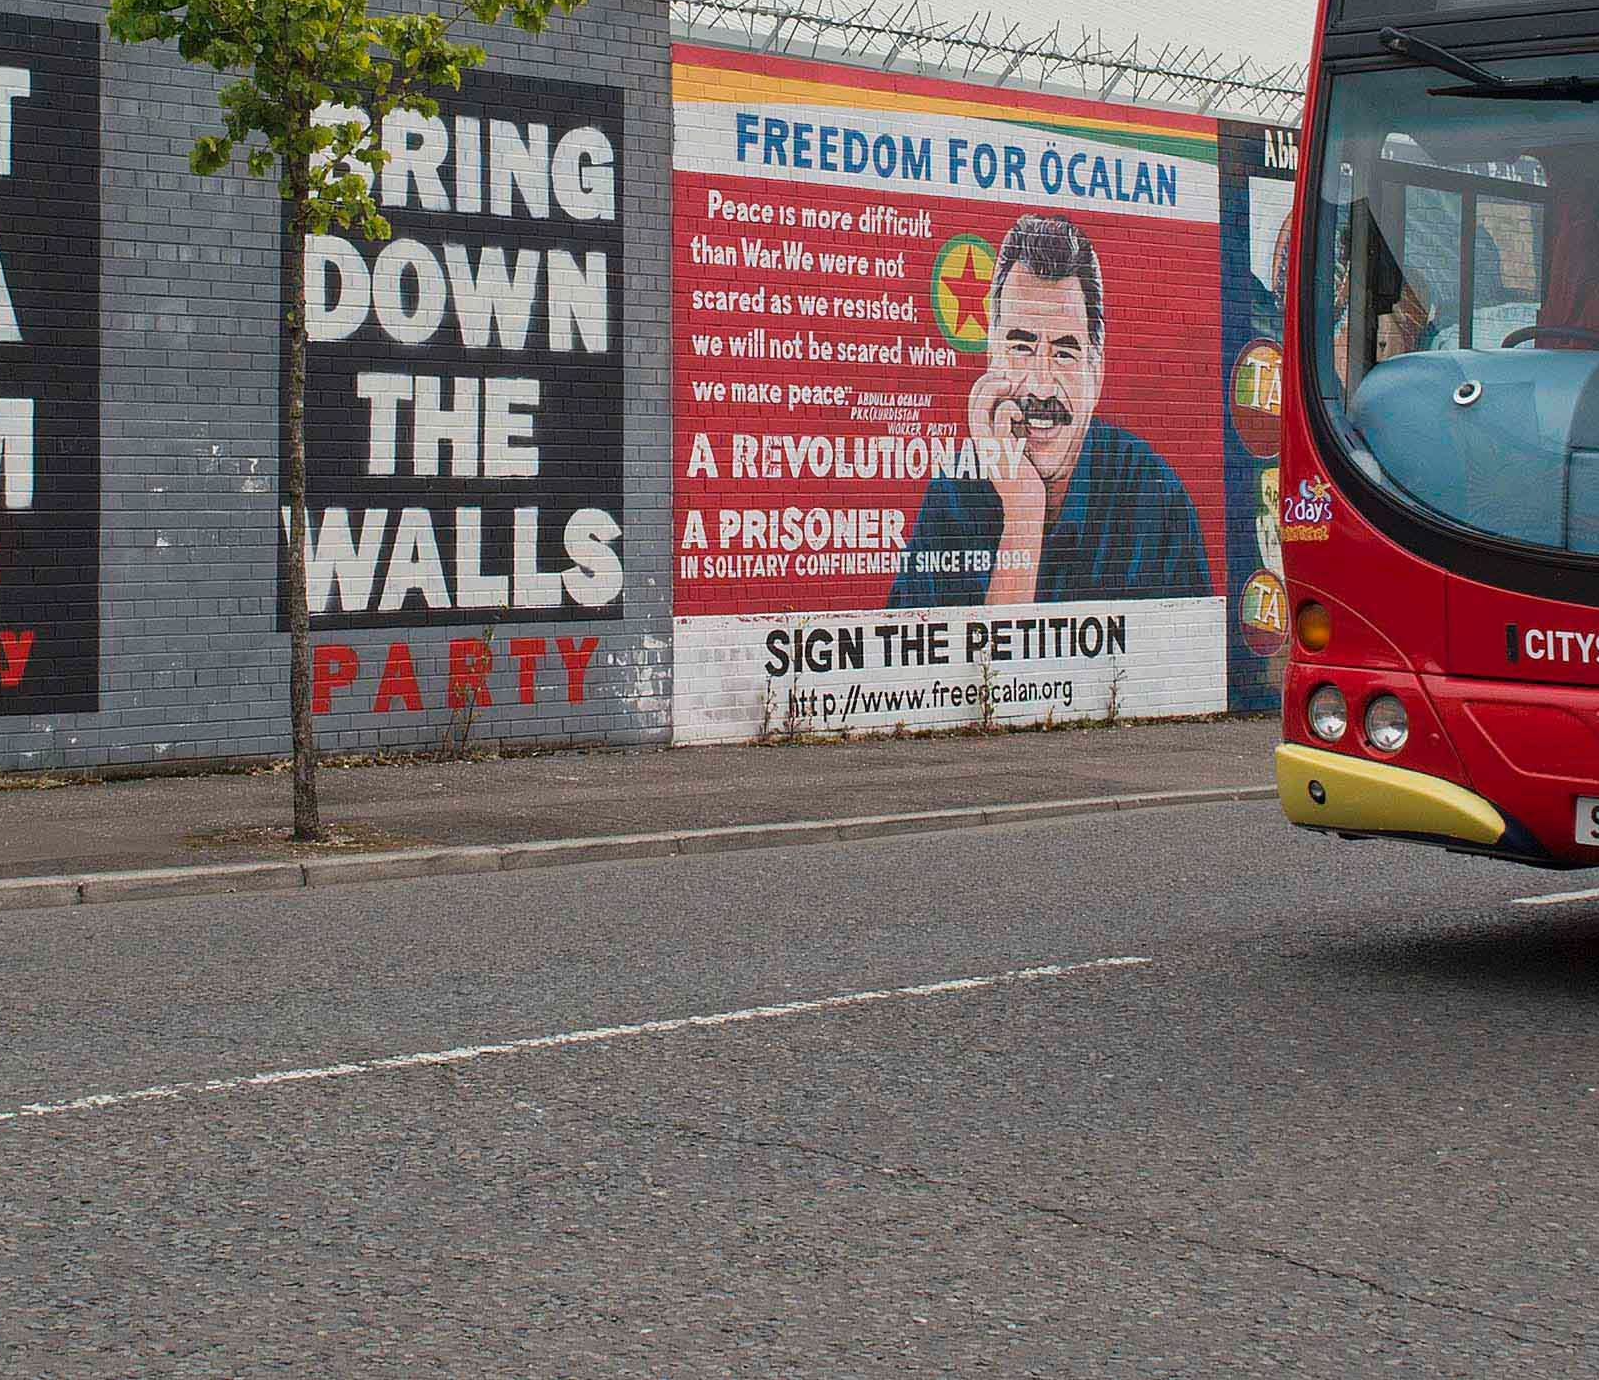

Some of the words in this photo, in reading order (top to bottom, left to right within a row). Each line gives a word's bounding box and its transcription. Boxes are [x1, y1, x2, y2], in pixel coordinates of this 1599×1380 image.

[736, 112, 932, 183] FREEDOM
[949, 139, 1026, 191] FOR
[1039, 141, 1178, 208] ÖCALAN
[708, 189, 773, 224] Peace
[779, 206, 796, 226] is
[801, 208, 852, 231] more
[858, 206, 932, 238] difficult
[690, 235, 737, 266] than
[819, 253, 867, 275] were
[875, 252, 905, 278] not
[305, 234, 607, 353] DOWN
[692, 287, 764, 314] scared
[770, 293, 792, 315] as
[797, 295, 828, 317] we
[691, 334, 723, 357] we
[729, 328, 765, 359] will
[770, 331, 803, 361] not
[808, 331, 833, 361] be
[837, 337, 902, 365] scared
[908, 338, 957, 367] when
[691, 381, 724, 402] we
[731, 381, 782, 403] make
[857, 392, 895, 406] ABDULLA
[357, 372, 539, 477] THE
[887, 422, 921, 435] WORKER
[687, 432, 719, 479] A
[733, 434, 1027, 480] REVOLUTIONARY
[681, 509, 708, 550] A
[719, 506, 907, 552] PRISONER
[281, 506, 624, 615] WALLS
[681, 556, 698, 579] IN
[704, 554, 788, 579] SOLITARY
[795, 550, 911, 576] CONFINEMENT
[915, 550, 960, 573] SINCE
[964, 550, 991, 572] FEB
[764, 626, 865, 678] SIGN
[875, 623, 949, 668] THE
[966, 615, 1126, 663] PETITION
[311, 636, 599, 715] PARTY
